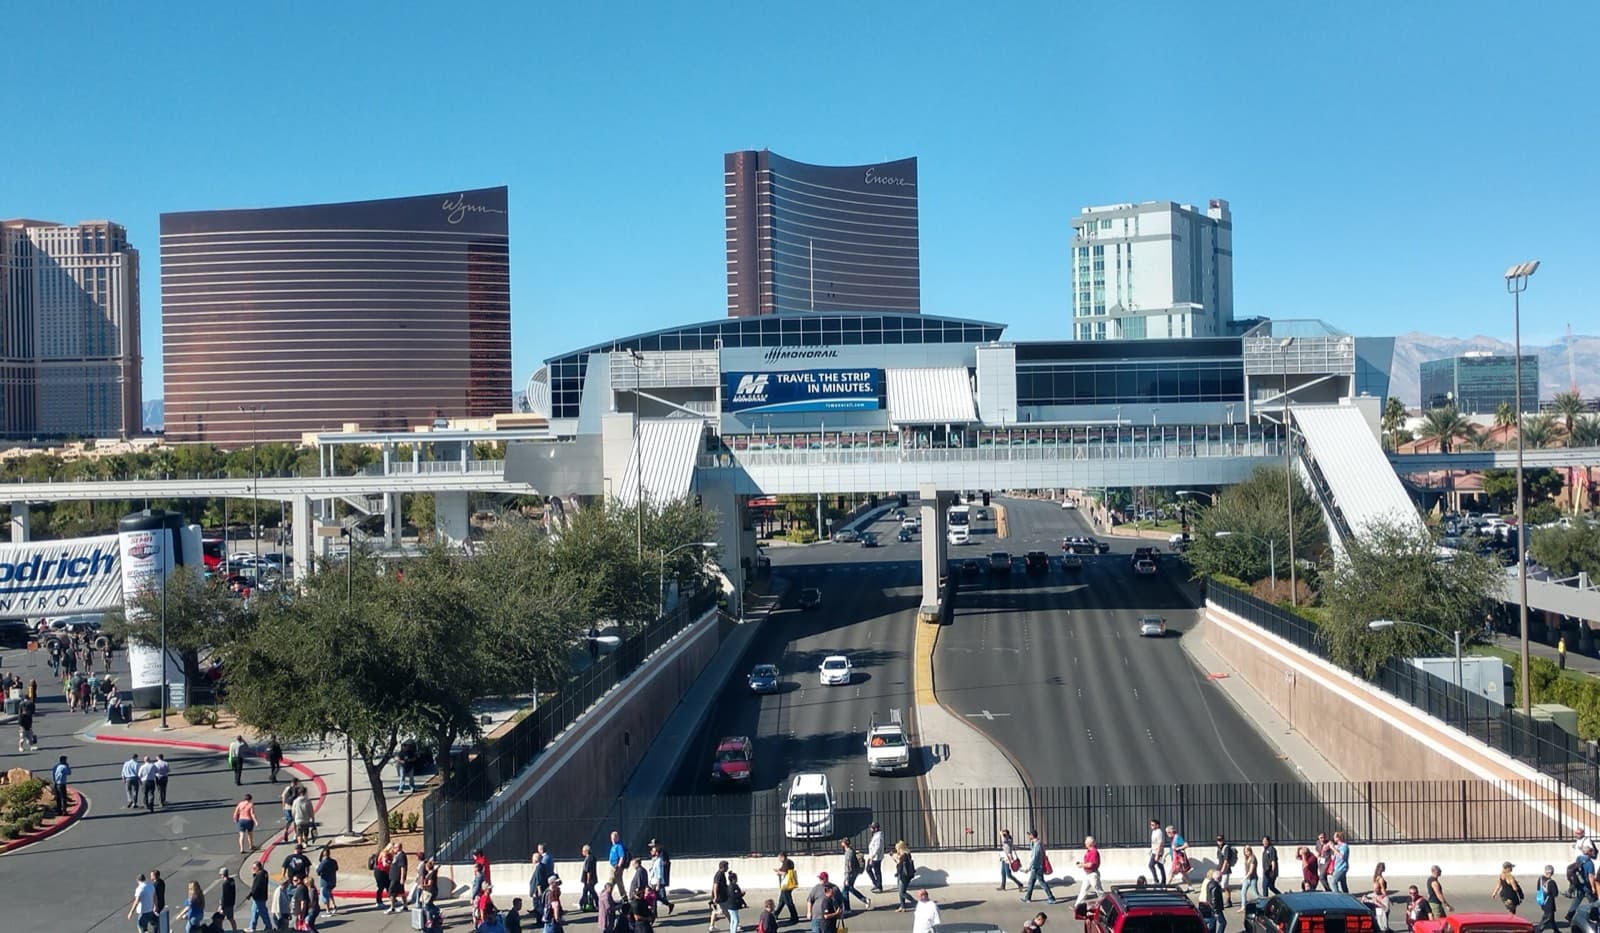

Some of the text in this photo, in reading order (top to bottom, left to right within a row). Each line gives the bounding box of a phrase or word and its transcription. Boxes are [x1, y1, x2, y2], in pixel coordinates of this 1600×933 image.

[864, 167, 915, 186] Encore
[442, 193, 503, 224] Wynn
[780, 349, 838, 359] MONORAIL
[776, 372, 871, 384] TRAVEL THE STRIP
[807, 383, 873, 393] IN MINUTES.
